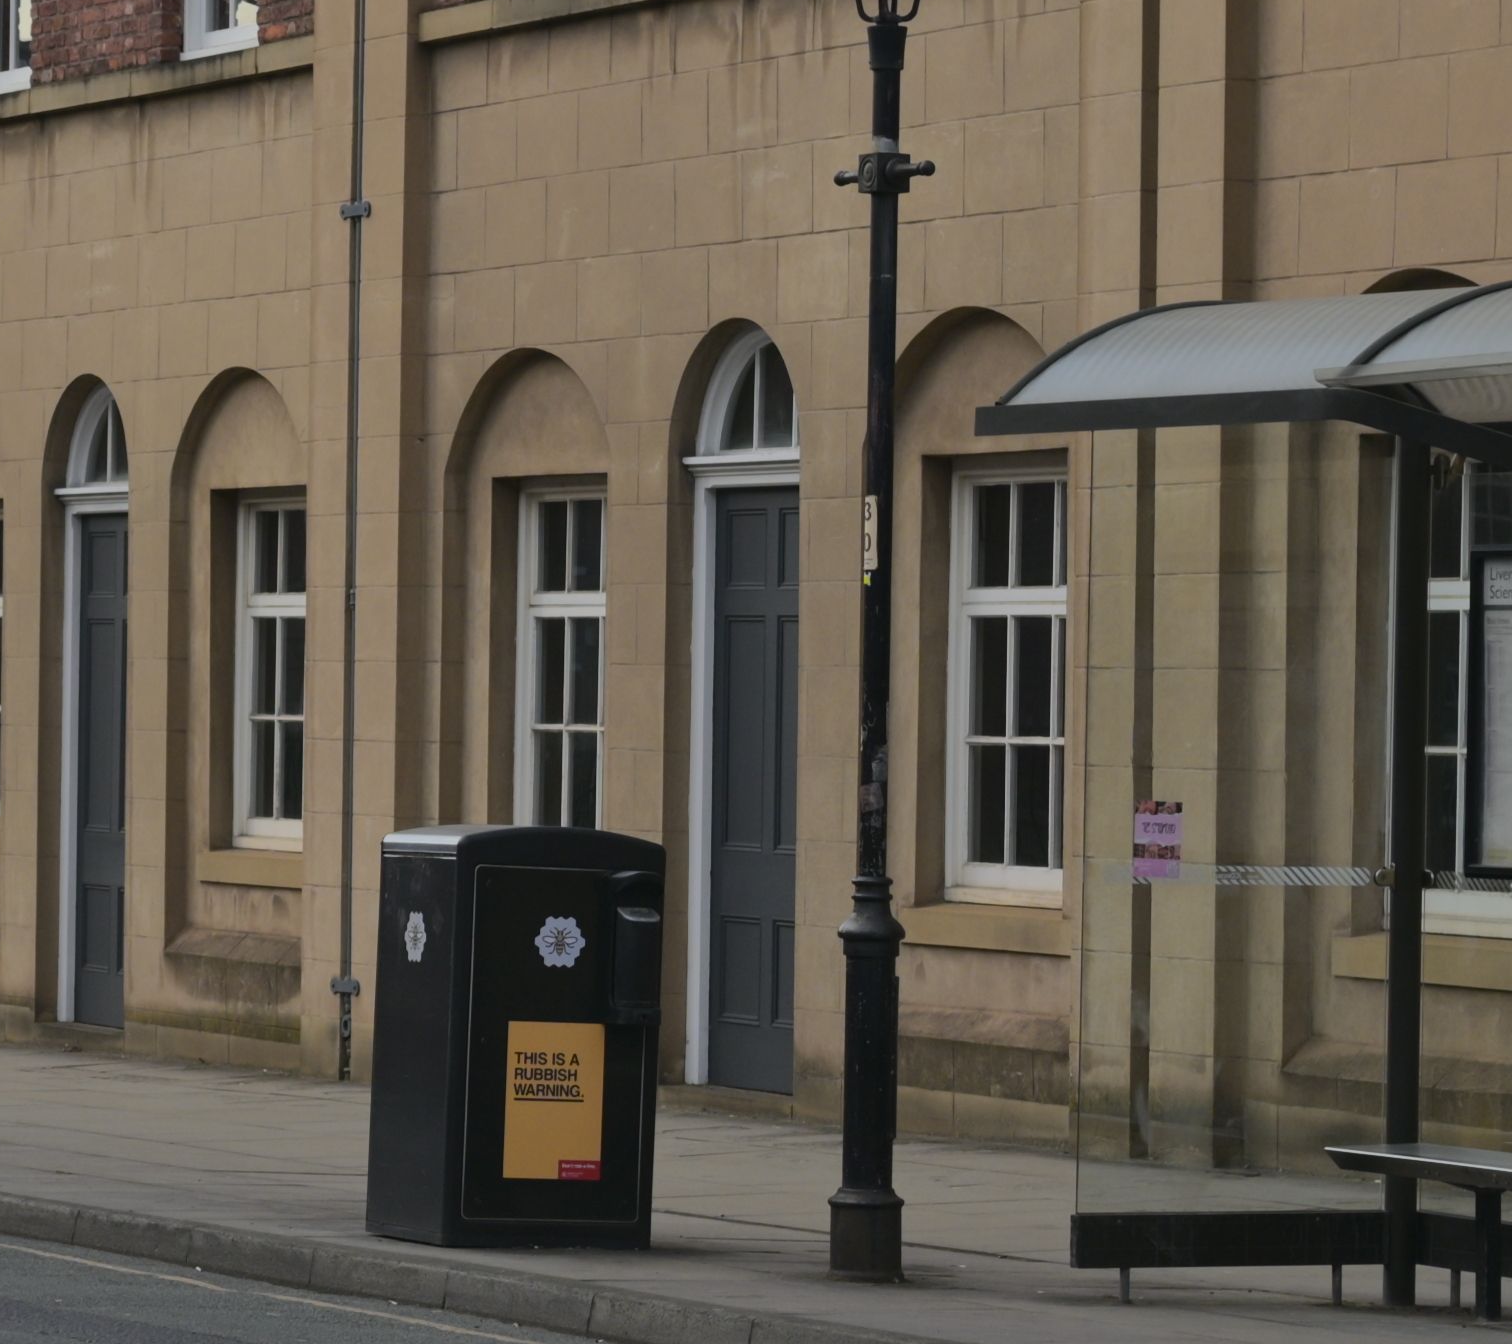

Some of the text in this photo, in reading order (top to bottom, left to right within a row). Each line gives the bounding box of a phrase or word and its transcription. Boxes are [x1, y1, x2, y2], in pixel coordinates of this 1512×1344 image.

[514, 1052, 580, 1066] THIS IS A
[514, 1067, 578, 1082] RUBBISH
[513, 1083, 584, 1098] WARNING.
